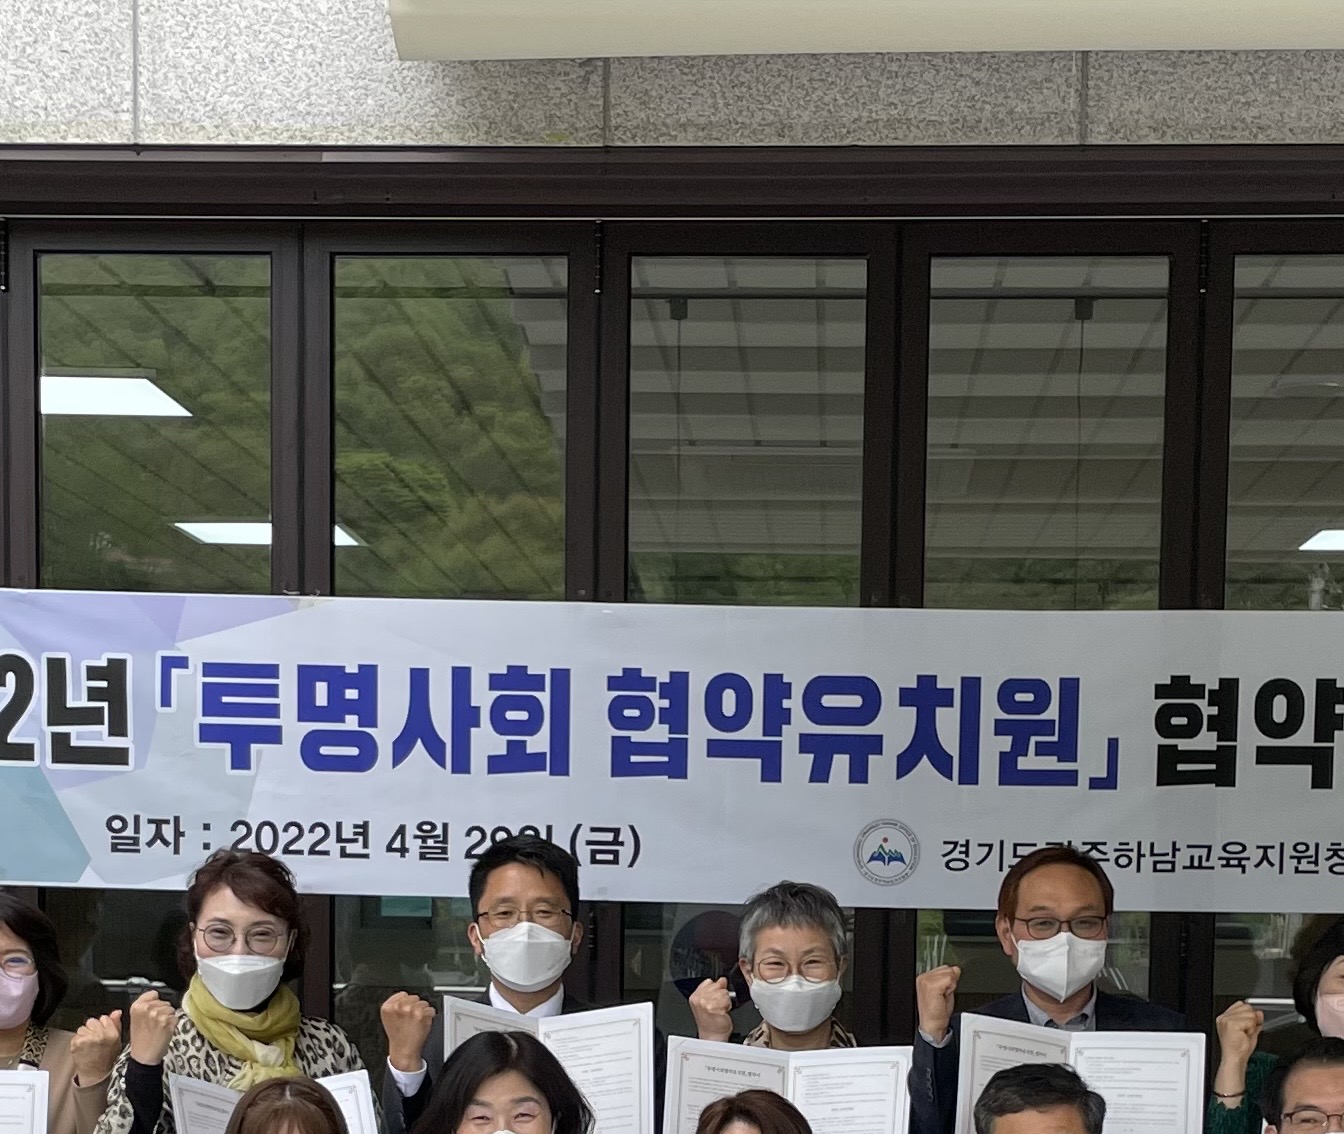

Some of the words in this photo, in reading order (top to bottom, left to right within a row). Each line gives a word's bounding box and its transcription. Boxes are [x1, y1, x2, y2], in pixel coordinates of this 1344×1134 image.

[160, 655, 571, 777] 「투명사회
[607, 667, 1119, 792] 협약유치원」
[106, 814, 186, 855] 일자
[230, 819, 370, 860] 2022년
[385, 821, 449, 862] 4월
[569, 823, 641, 868] (금)
